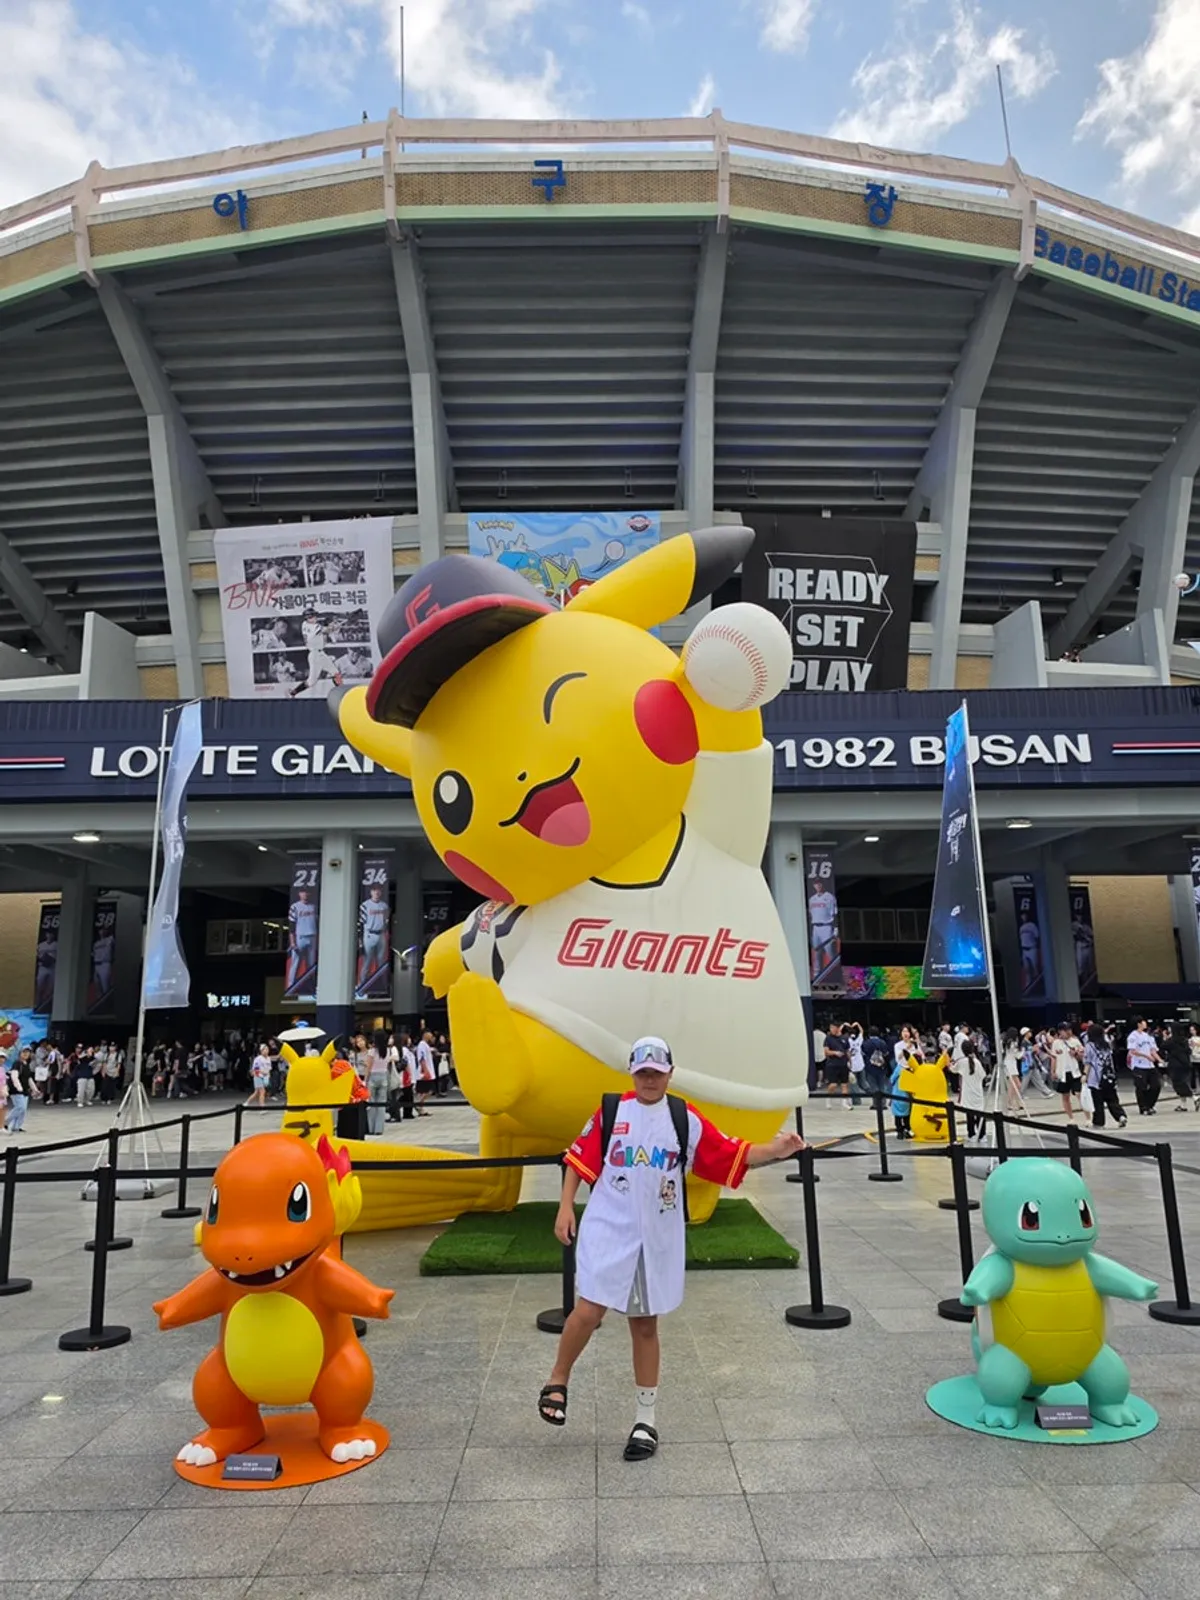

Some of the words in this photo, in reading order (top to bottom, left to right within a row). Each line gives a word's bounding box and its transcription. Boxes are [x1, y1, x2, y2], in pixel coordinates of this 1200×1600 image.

[532, 160, 566, 201] 구
[864, 183, 899, 227] 장
[1034, 226, 1154, 295] Baseball
[768, 567, 889, 605] READY
[796, 613, 865, 648] SET
[786, 660, 873, 692] PLAY
[775, 738, 897, 768] 1982
[293, 869, 318, 887] 21
[362, 868, 387, 885] 34
[808, 861, 832, 878] 16
[557, 916, 770, 980] Giants
[609, 1139, 680, 1171] GIANT
